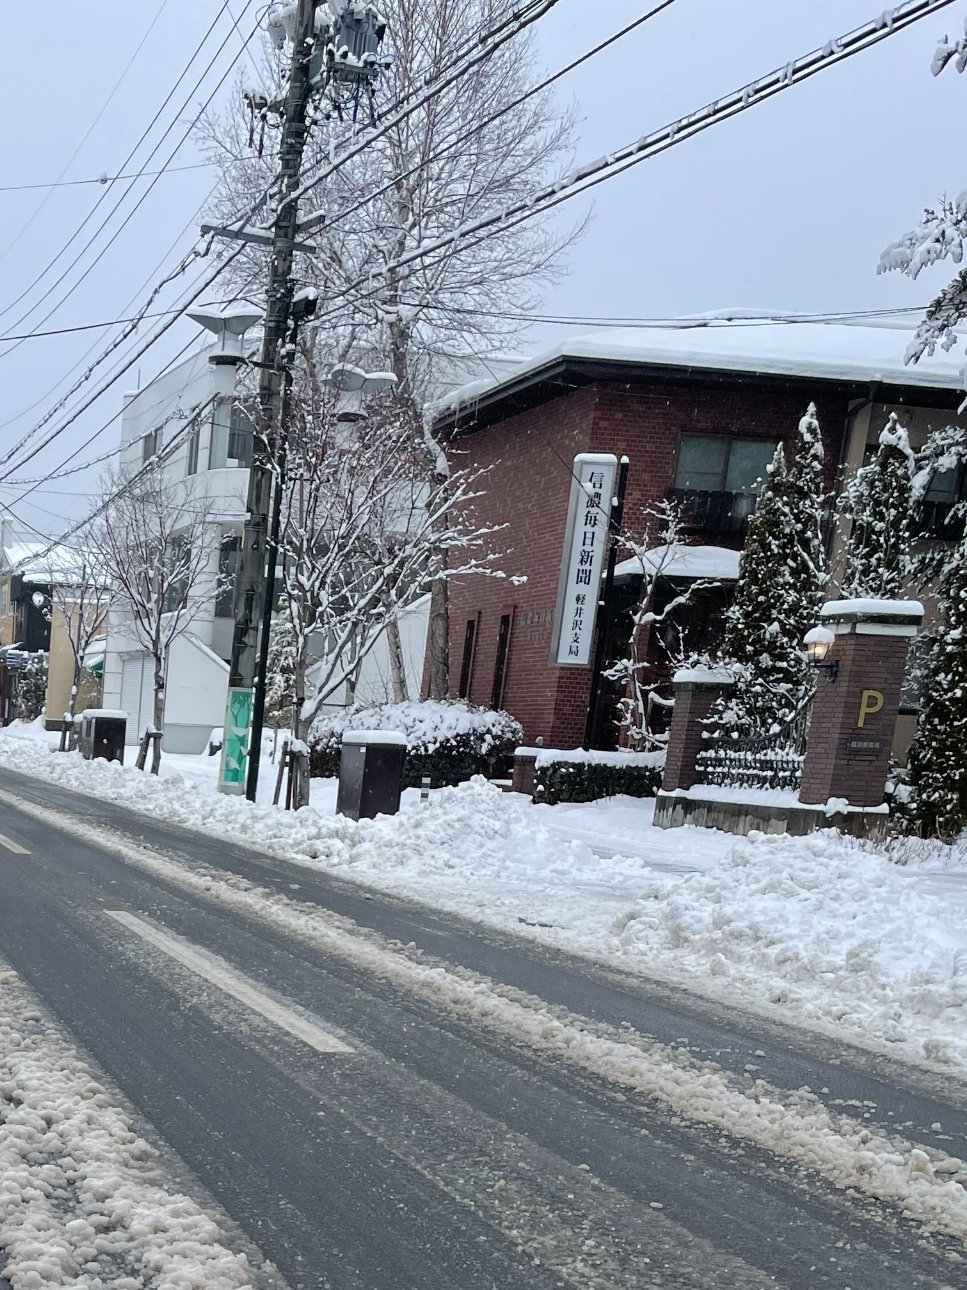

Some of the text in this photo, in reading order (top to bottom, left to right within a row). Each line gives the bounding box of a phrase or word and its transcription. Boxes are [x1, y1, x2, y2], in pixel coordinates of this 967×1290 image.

[568, 471, 605, 657] 信濃毎日新聞 軽井沢支局
[857, 689, 884, 728] P
